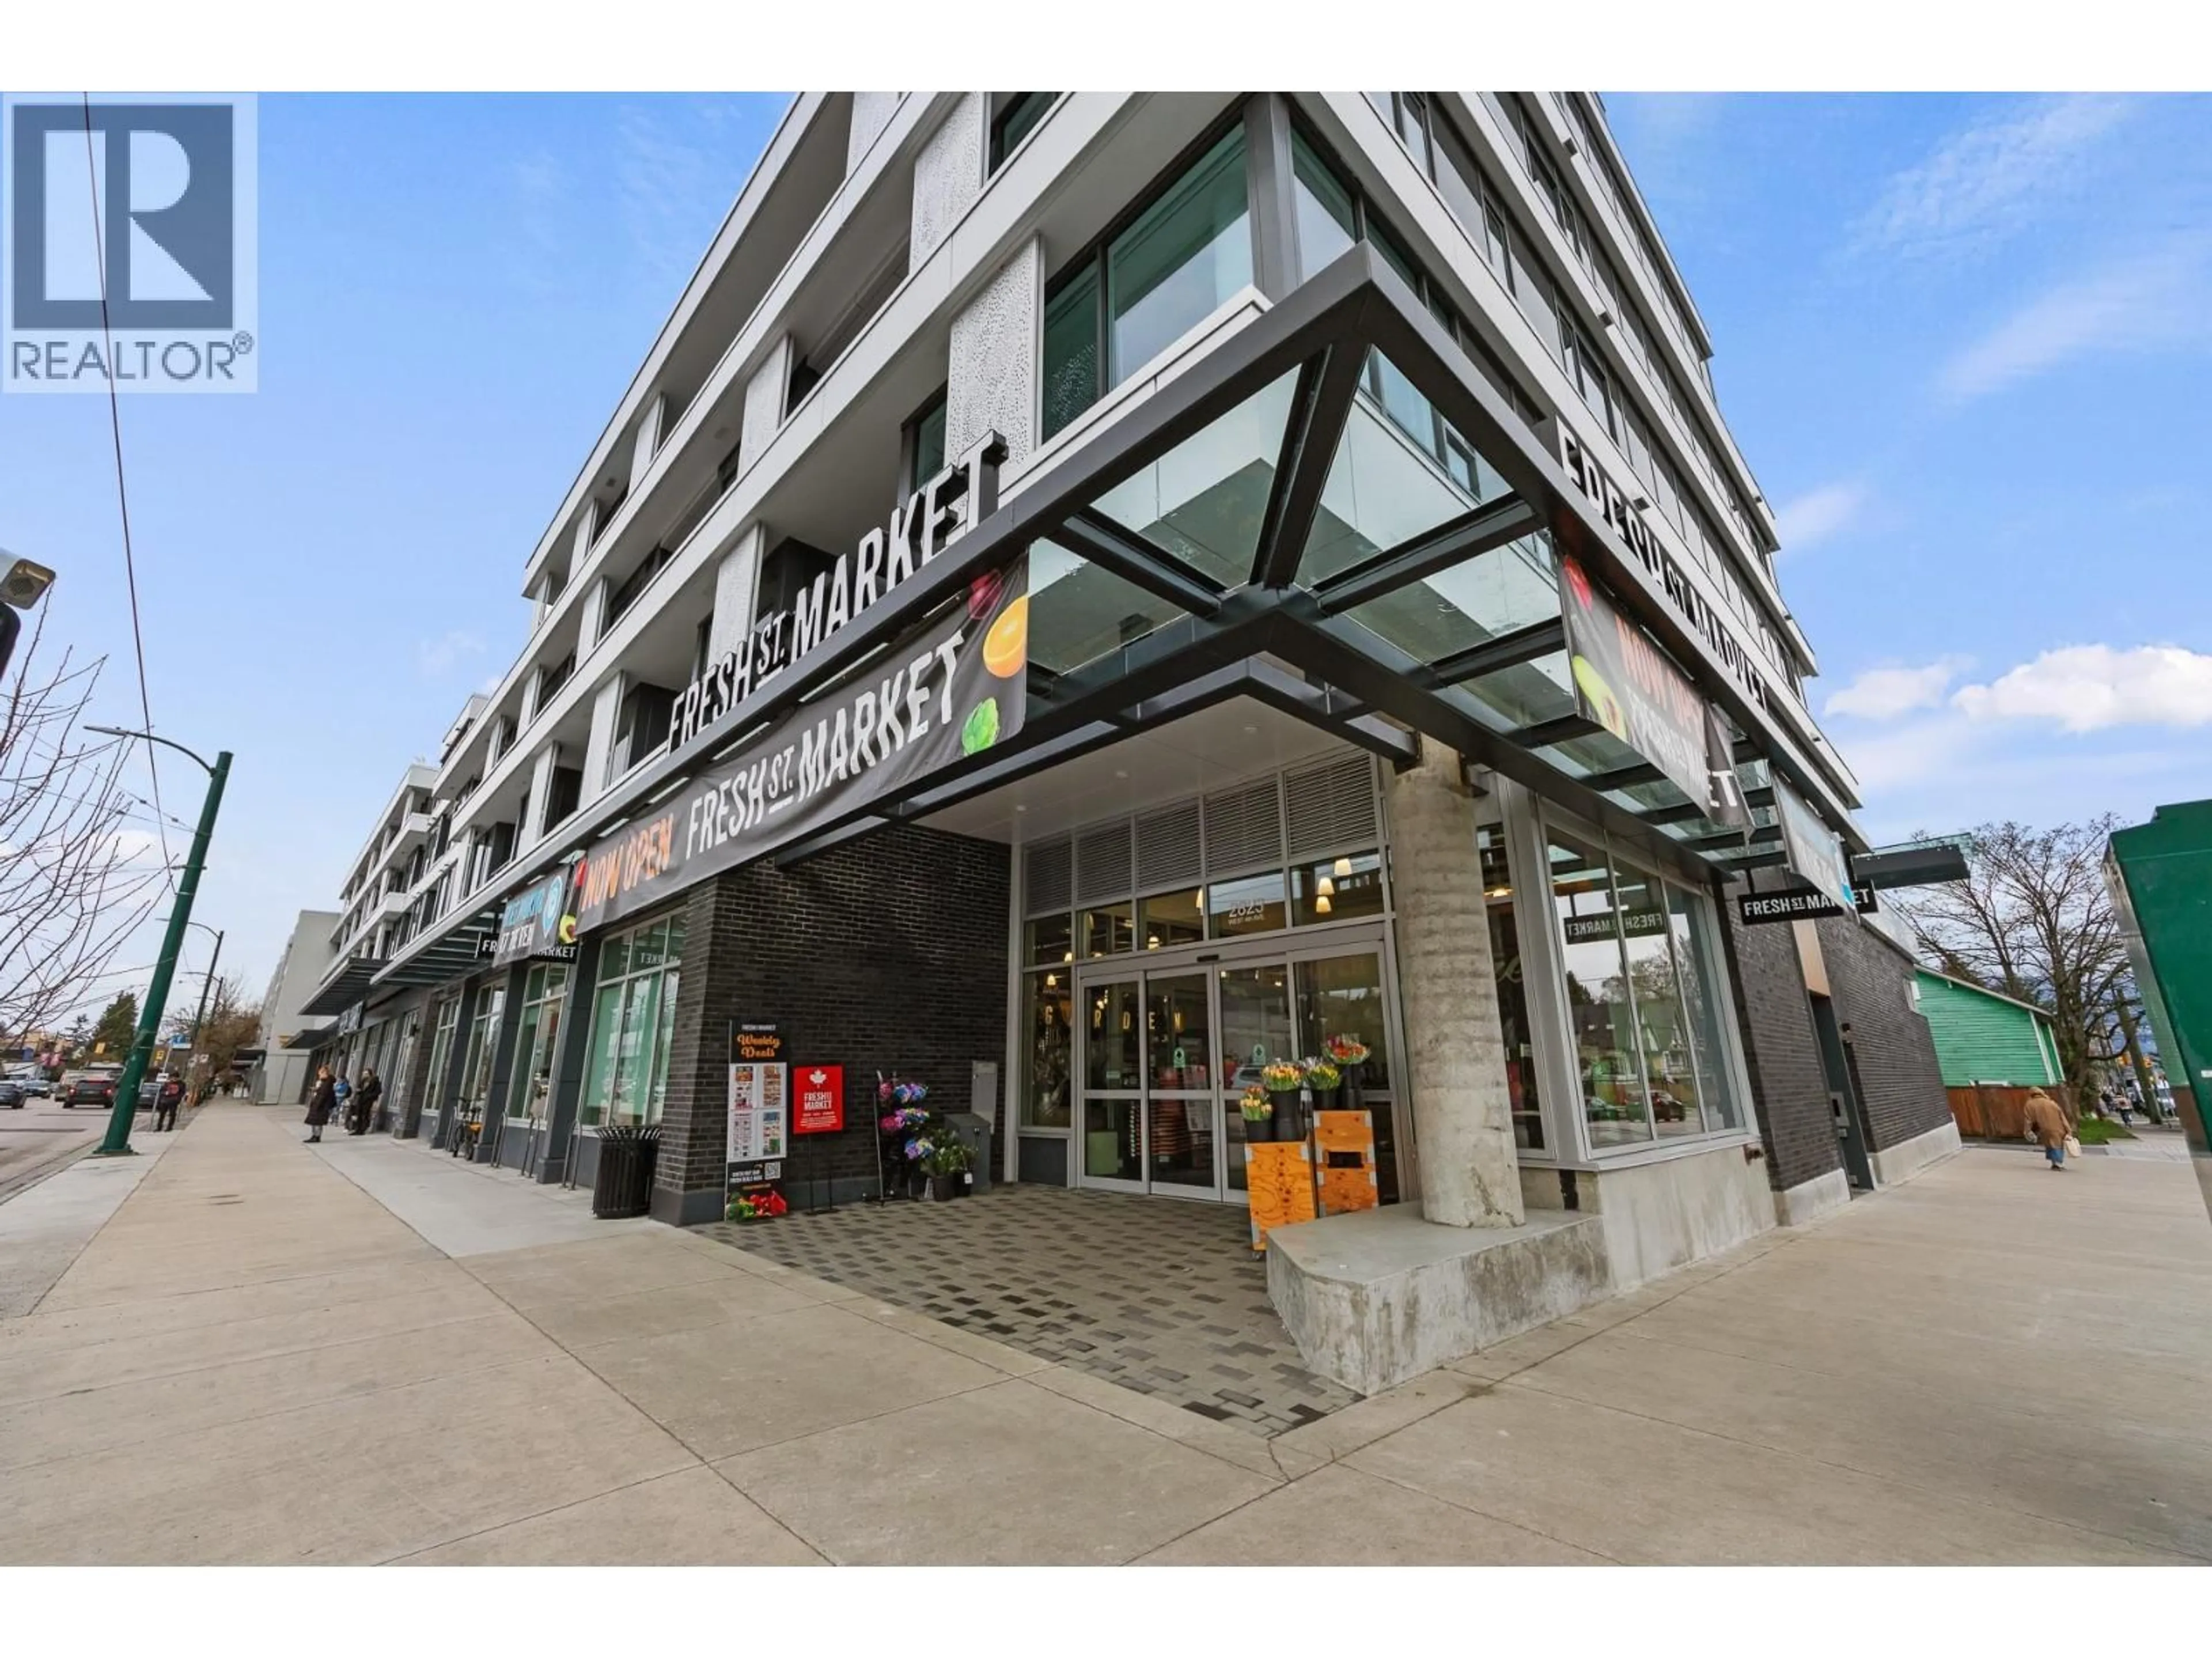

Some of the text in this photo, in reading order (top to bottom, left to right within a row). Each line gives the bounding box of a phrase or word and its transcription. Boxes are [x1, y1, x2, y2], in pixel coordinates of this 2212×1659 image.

[668, 429, 1003, 756] FRESH ST. MARKET
[581, 843, 624, 912] NOW
[623, 813, 674, 892] OPEN
[685, 757, 767, 861] FRESH
[768, 744, 794, 799] ST.
[797, 629, 964, 803] MARKET
[1744, 896, 1791, 916] FRESH
[1806, 888, 1869, 910] MAET
[532, 946, 576, 959] ARKET
[1044, 1005, 1181, 1031] GRDEN
